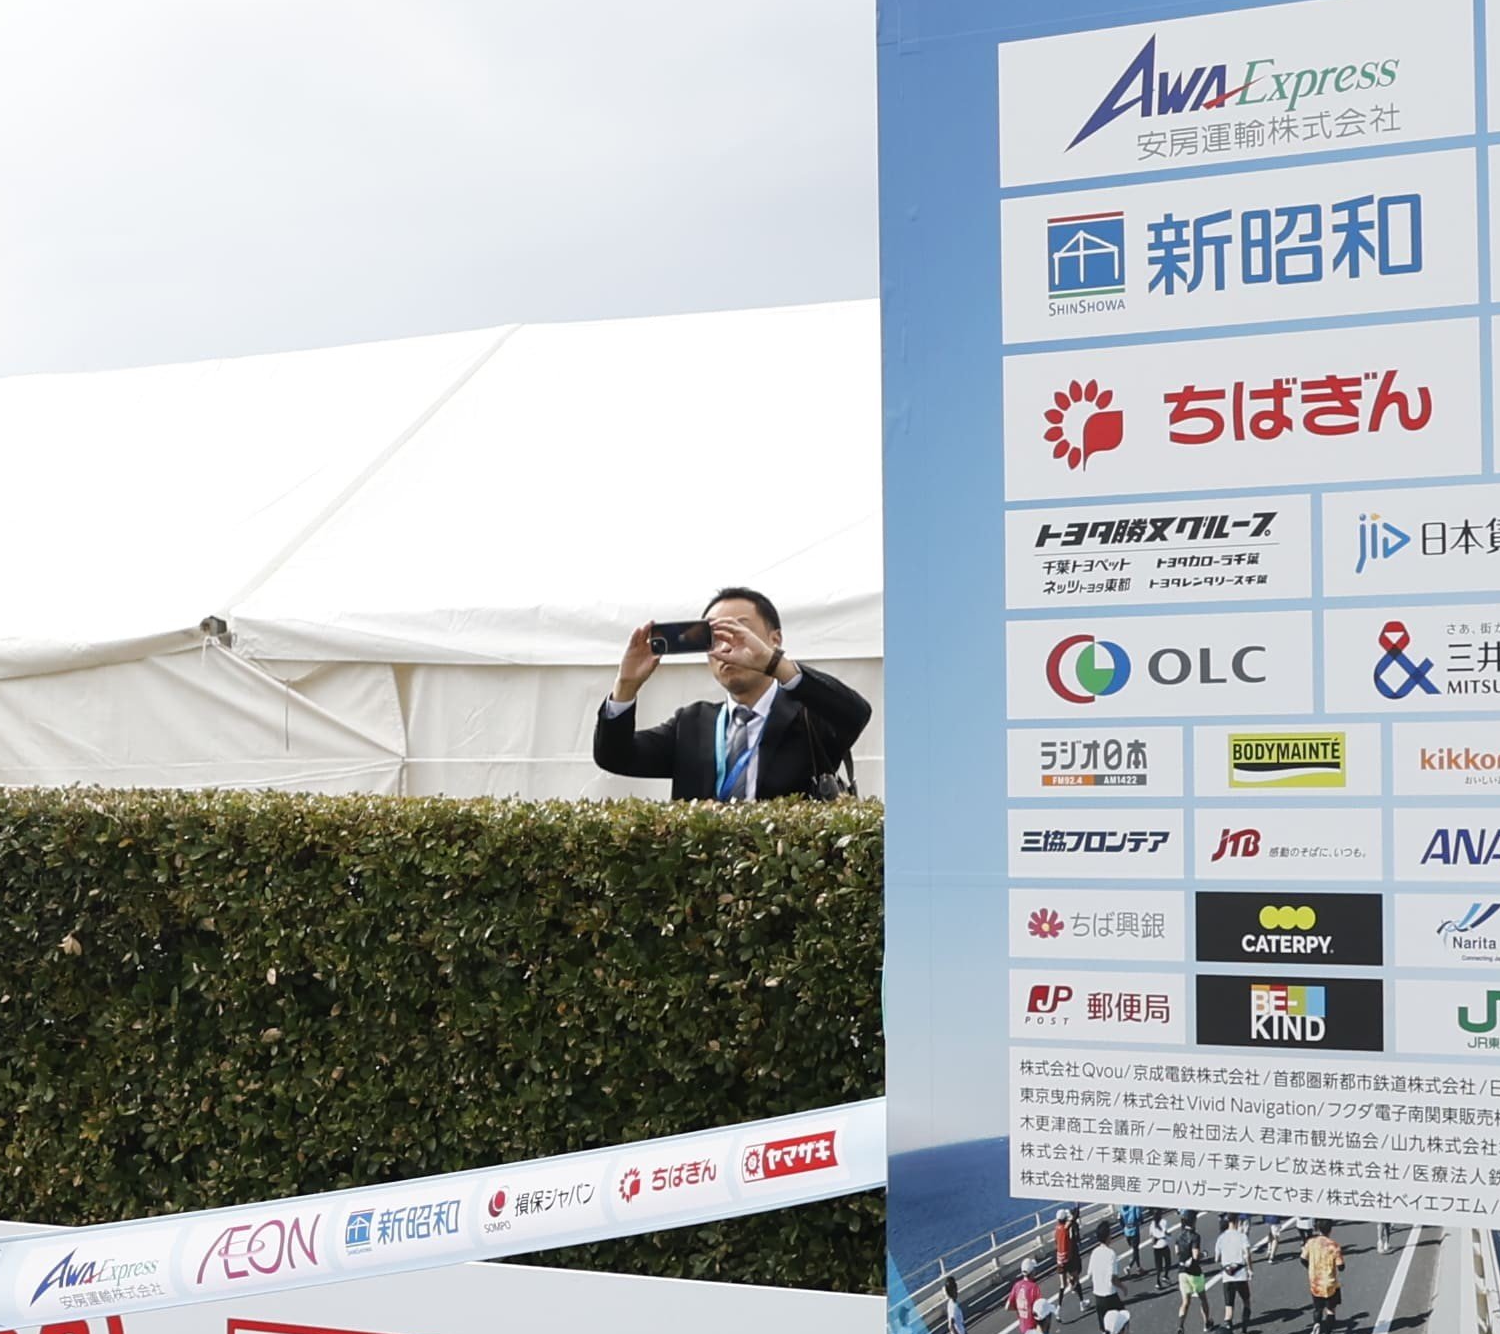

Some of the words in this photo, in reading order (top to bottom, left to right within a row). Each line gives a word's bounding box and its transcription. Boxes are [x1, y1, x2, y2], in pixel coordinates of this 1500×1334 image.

[1231, 54, 1400, 113] Express
[1136, 101, 1402, 161] 安房運輸株式会社
[1147, 193, 1423, 297] 新昭和
[1164, 369, 1432, 445] ちばぎん
[1042, 558, 1131, 575] 千葉トヨペット
[1156, 552, 1259, 568] トヨタカローラ千葉
[1043, 578, 1131, 594] ネッツトヨタ東都
[1149, 575, 1268, 588] トヨタレンタリース千葉
[1148, 644, 1266, 685] OLC
[1040, 738, 1148, 771] ラジオ日本
[1052, 776, 1083, 785] FM92.4
[1104, 775, 1137, 785] AM1422
[1020, 829, 1170, 854] 三協フロンテア
[1211, 828, 1262, 863] JTB
[1268, 845, 1366, 859] 感動のそばに、いつも。
[1070, 911, 1165, 939] ちば興銀
[1241, 934, 1334, 955] CATERPY
[1452, 936, 1497, 950] Narita
[1024, 1016, 1069, 1026] POST
[1087, 992, 1170, 1024] 郵便局
[1250, 1014, 1326, 1042] KIND
[766, 1139, 832, 1171] ヤマザキ
[652, 1158, 717, 1192] ちばぎん
[514, 1183, 595, 1218] 損保ジャパン
[376, 1199, 460, 1245] 新昭和
[484, 1220, 511, 1234] SOMPO
[96, 1258, 158, 1285] Express
[59, 1283, 165, 1309] 安房運輸株式会社
